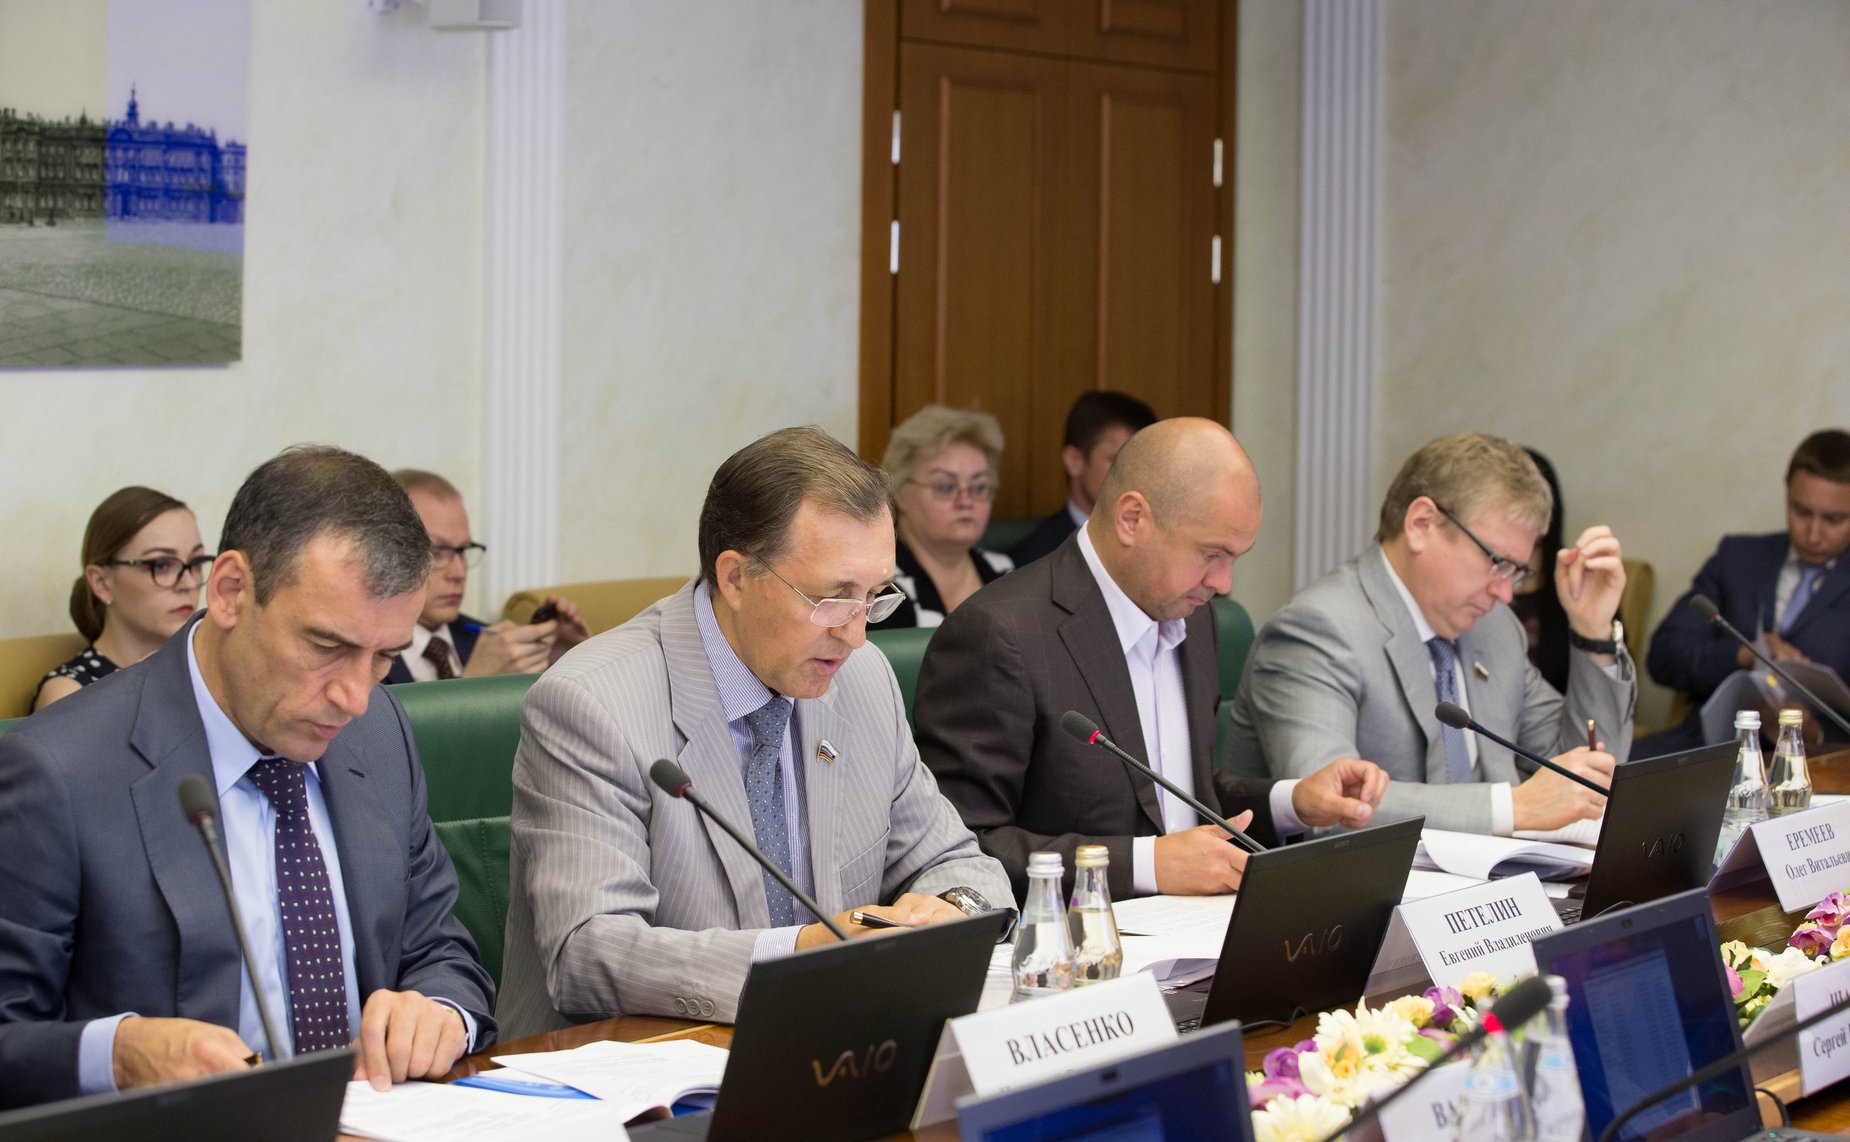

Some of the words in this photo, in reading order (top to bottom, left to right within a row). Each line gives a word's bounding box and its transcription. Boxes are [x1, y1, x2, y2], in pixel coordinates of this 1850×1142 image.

[1641, 832, 1685, 859] VAIO
[1785, 823, 1835, 851] ЕРЕМЕЕВ
[1785, 863, 1808, 880] Олег
[1443, 897, 1523, 934] ПЕТЕЛИН
[1284, 924, 1344, 962] VAIO
[1438, 940, 1486, 966] Евгений
[1006, 1010, 1134, 1065] ВЛАСЕНКО
[1813, 1027, 1848, 1058] Сергей
[811, 1039, 898, 1087] VAIO
